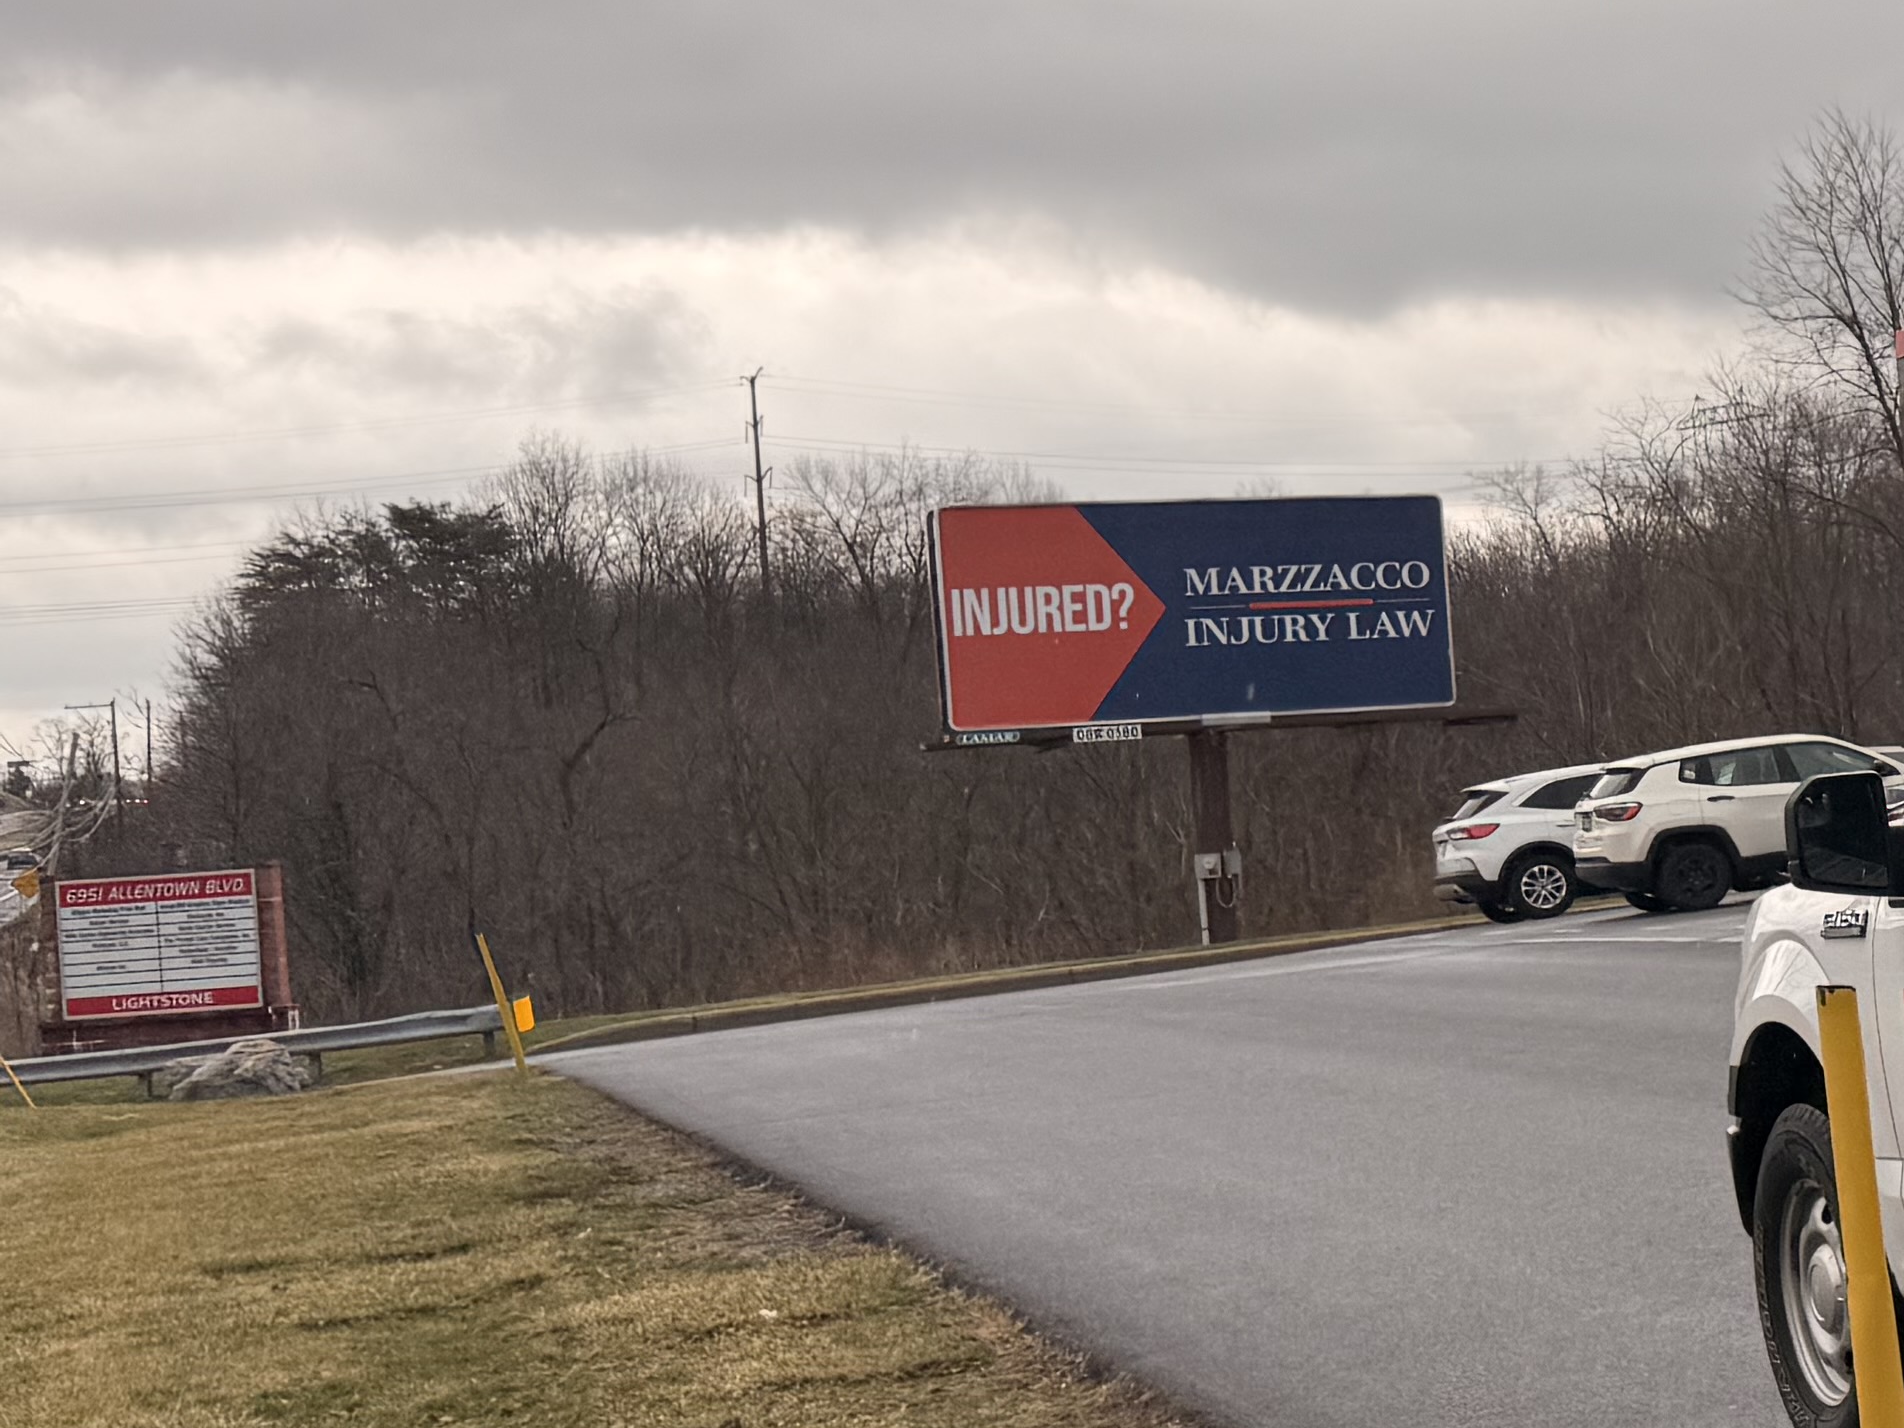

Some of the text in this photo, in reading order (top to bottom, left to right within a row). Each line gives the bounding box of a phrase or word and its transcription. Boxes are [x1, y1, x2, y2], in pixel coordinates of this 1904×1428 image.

[1183, 561, 1430, 596] MARZZACCO
[951, 582, 1134, 636] INJURED?
[1184, 609, 1435, 647] INJURY LAW
[108, 882, 200, 901] ALLENTOWN
[112, 991, 214, 1011] LIGHTSTONE
